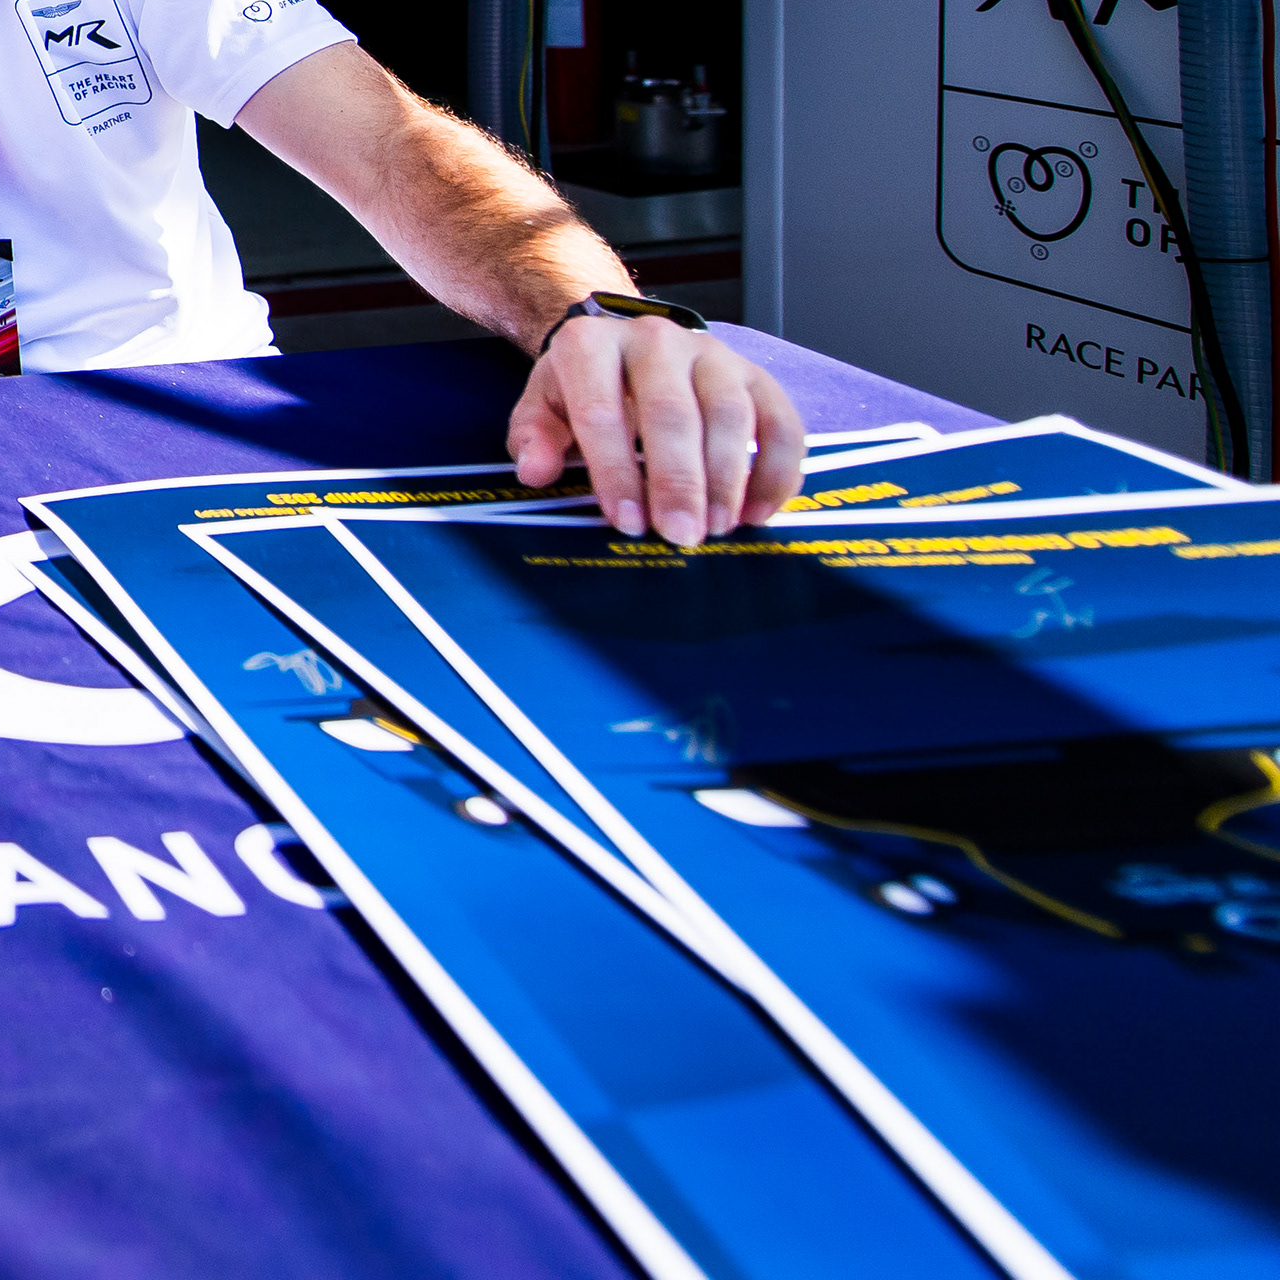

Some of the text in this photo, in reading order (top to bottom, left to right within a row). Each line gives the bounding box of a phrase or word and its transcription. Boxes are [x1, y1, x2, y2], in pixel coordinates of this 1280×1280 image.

[44, 19, 122, 51] MR
[68, 73, 135, 93] THE HEART
[73, 82, 137, 101] OF RACING
[92, 111, 132, 135] PARTNER
[1025, 323, 1126, 379] RACE
